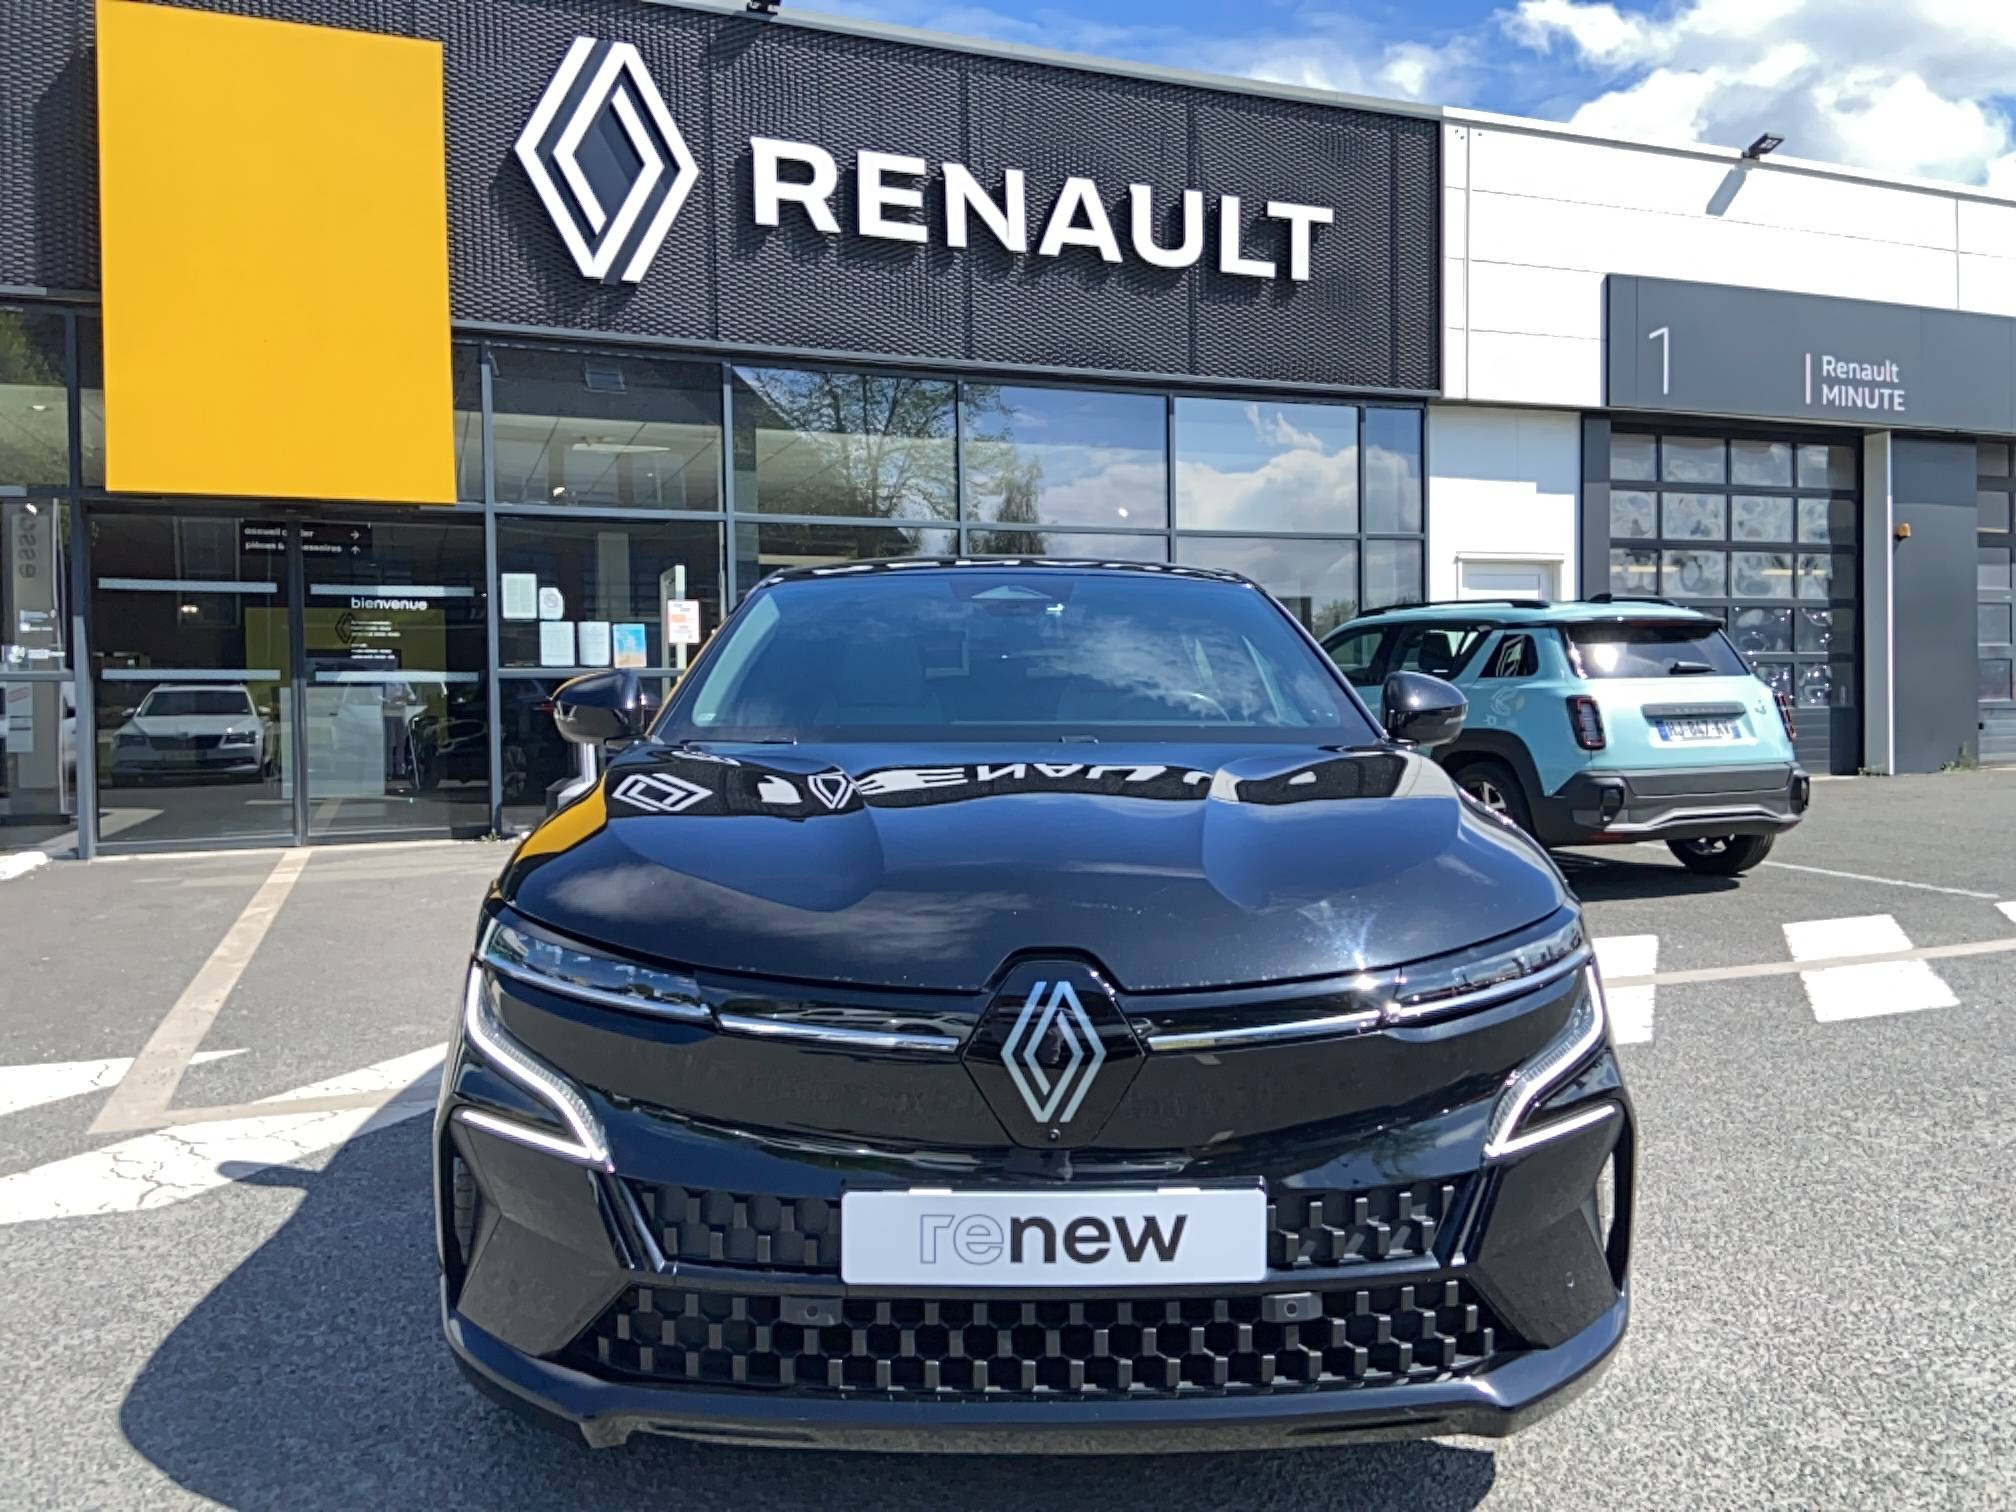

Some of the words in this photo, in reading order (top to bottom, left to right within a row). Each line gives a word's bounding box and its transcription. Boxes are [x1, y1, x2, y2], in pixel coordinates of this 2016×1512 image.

[751, 136, 1334, 281] RENAULT
[1648, 326, 1670, 395] 1
[1822, 355, 1900, 383] Renault
[1822, 383, 1906, 412] MINUTE
[351, 596, 428, 611] bienvenue
[919, 1214, 1188, 1265] renew
